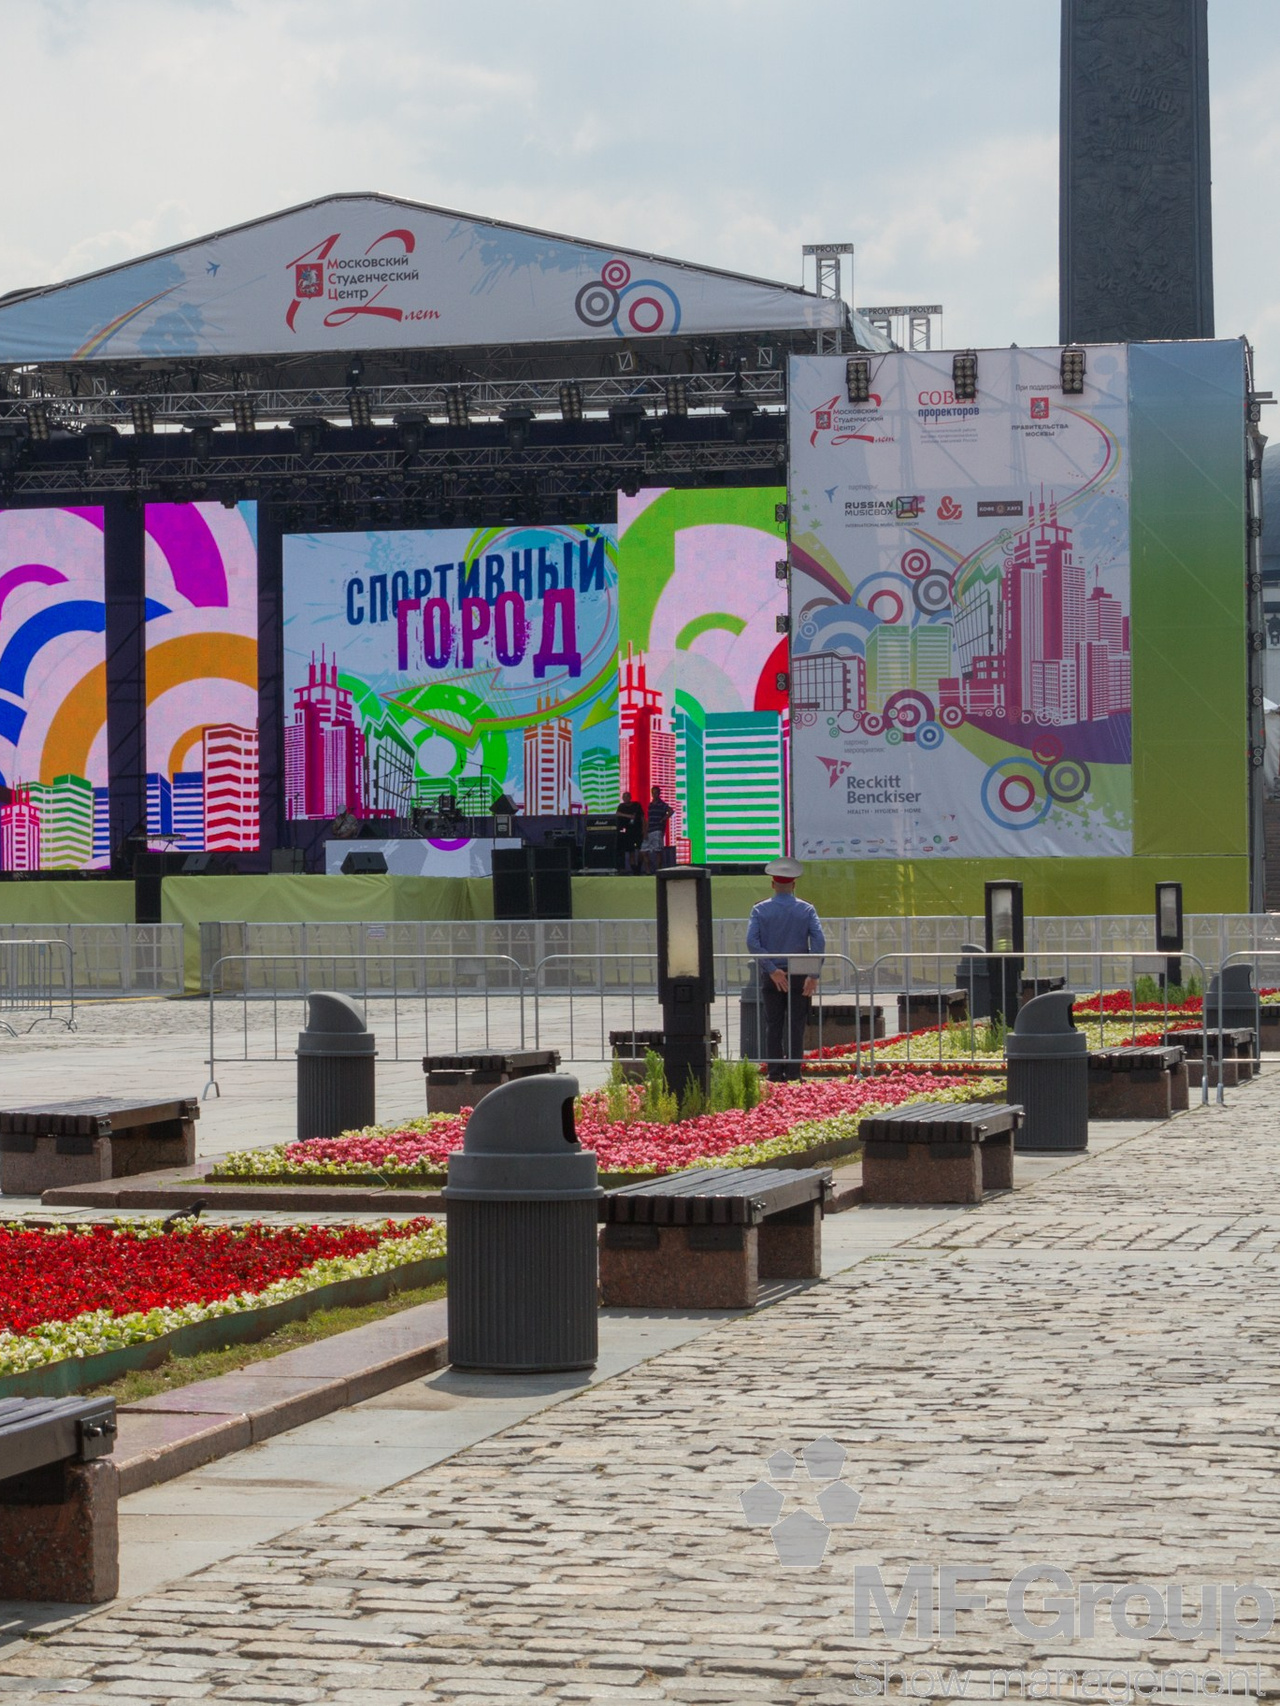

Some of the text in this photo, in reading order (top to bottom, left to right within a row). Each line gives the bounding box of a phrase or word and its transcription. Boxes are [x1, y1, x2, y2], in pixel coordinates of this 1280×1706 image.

[326, 254, 409, 270] Московский
[327, 269, 420, 285] Студенческий
[327, 287, 369, 301] Центр
[404, 307, 441, 321] лет
[833, 408, 879, 416] Московский
[918, 407, 980, 425] проректоров
[833, 416, 885, 424] Студенческий
[833, 425, 857, 433] Центр
[845, 501, 894, 510] RUSSIAN
[345, 526, 608, 627] СПОРТИВНЫЙ
[394, 587, 584, 679] ГОРОД
[846, 775, 902, 789] Reckitt
[846, 790, 922, 804] Benckiser
